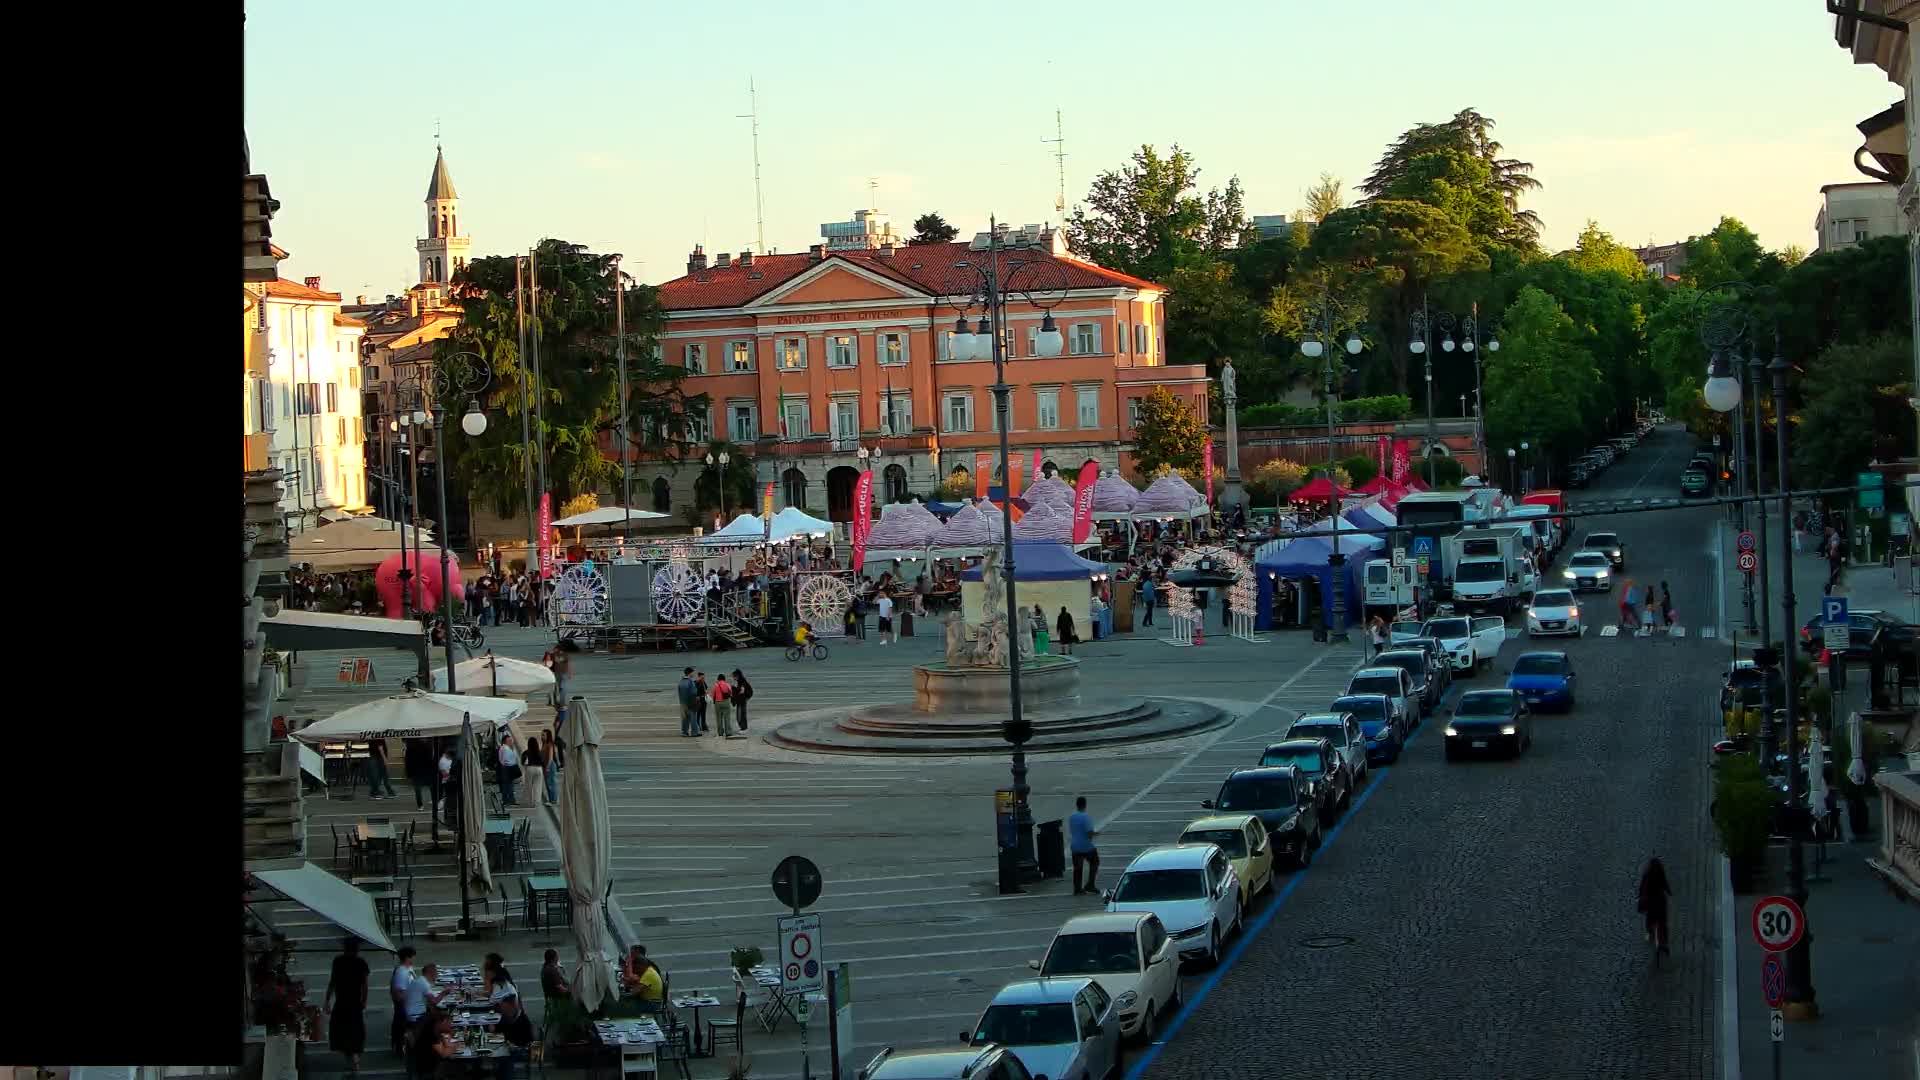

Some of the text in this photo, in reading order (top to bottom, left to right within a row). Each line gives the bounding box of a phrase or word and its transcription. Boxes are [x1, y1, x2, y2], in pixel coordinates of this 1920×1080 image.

[1743, 557, 1753, 566] 20
[1827, 601, 1842, 621] P
[1762, 911, 1791, 936] 30
[790, 968, 798, 977] 10
